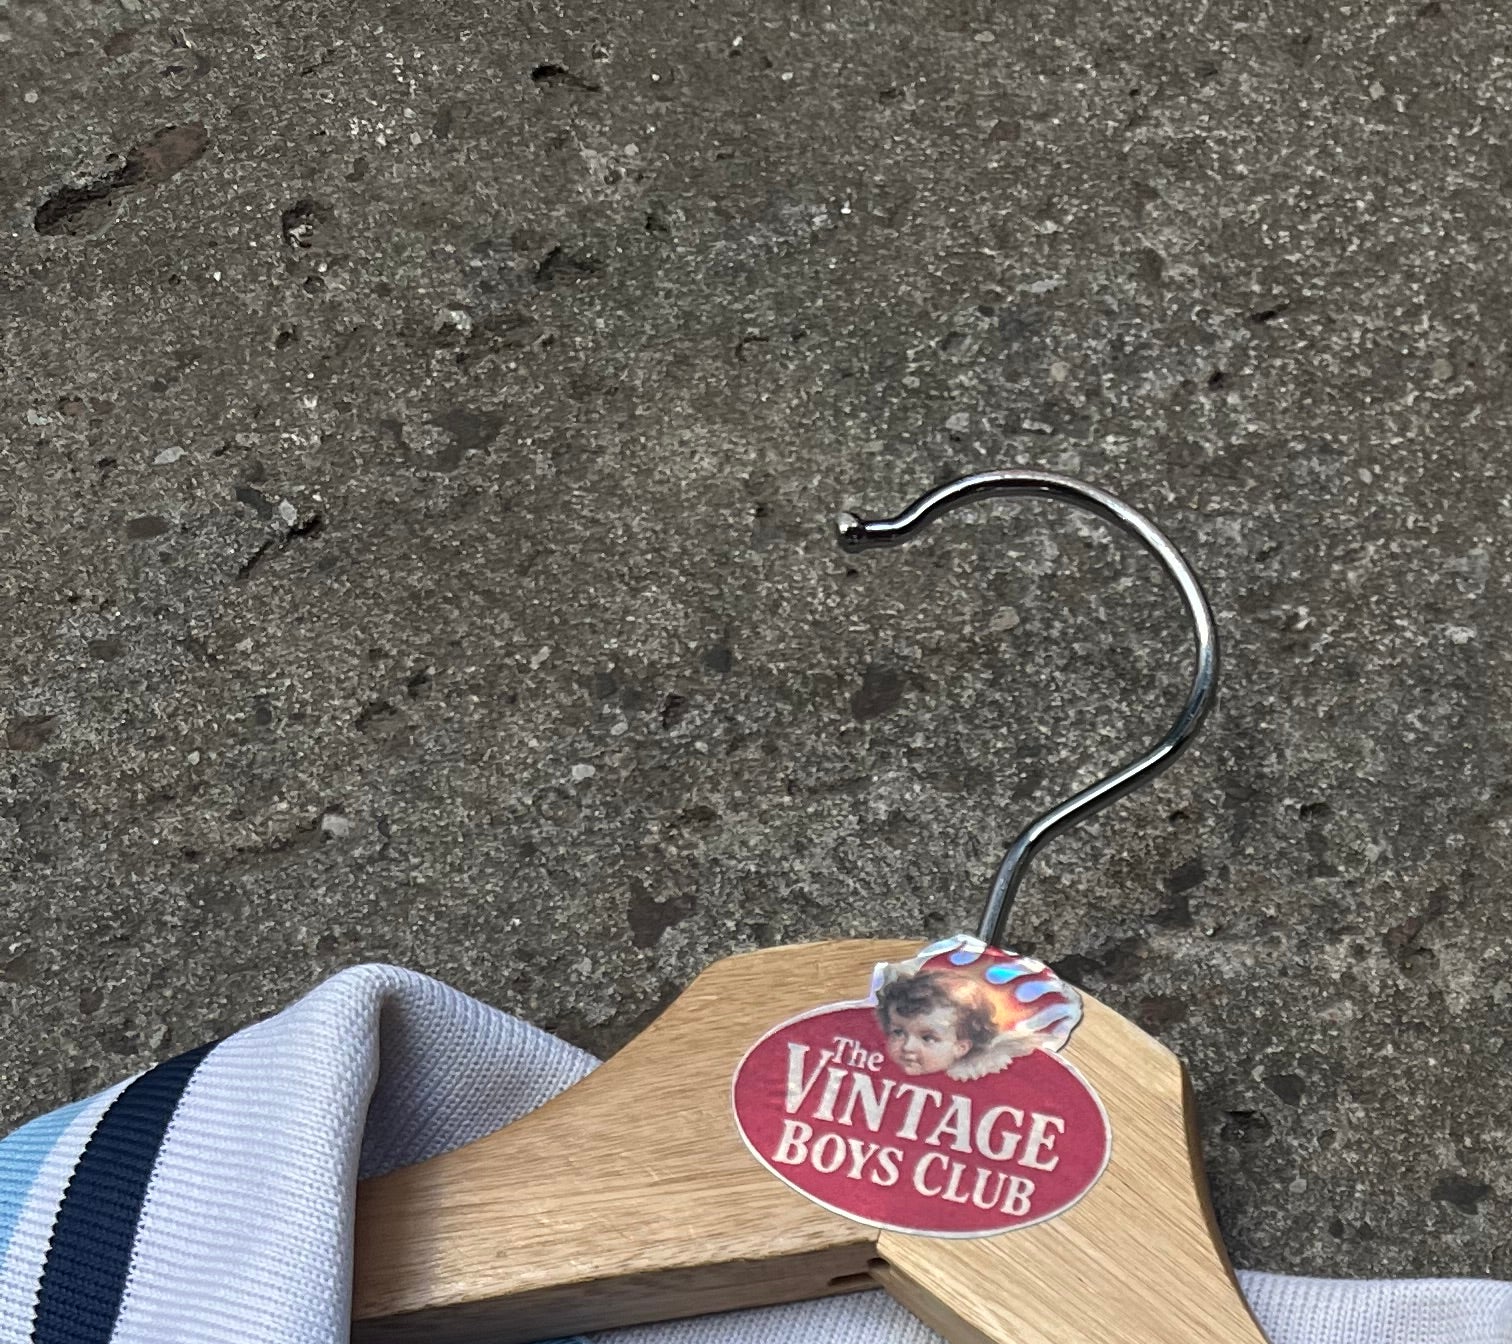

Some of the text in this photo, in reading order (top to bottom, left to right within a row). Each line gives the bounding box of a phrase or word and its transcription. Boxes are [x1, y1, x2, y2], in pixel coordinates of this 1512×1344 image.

[832, 1036, 884, 1072] The
[785, 1042, 1065, 1171] VINTAGE
[771, 1119, 1036, 1217] BOYS CLUB
